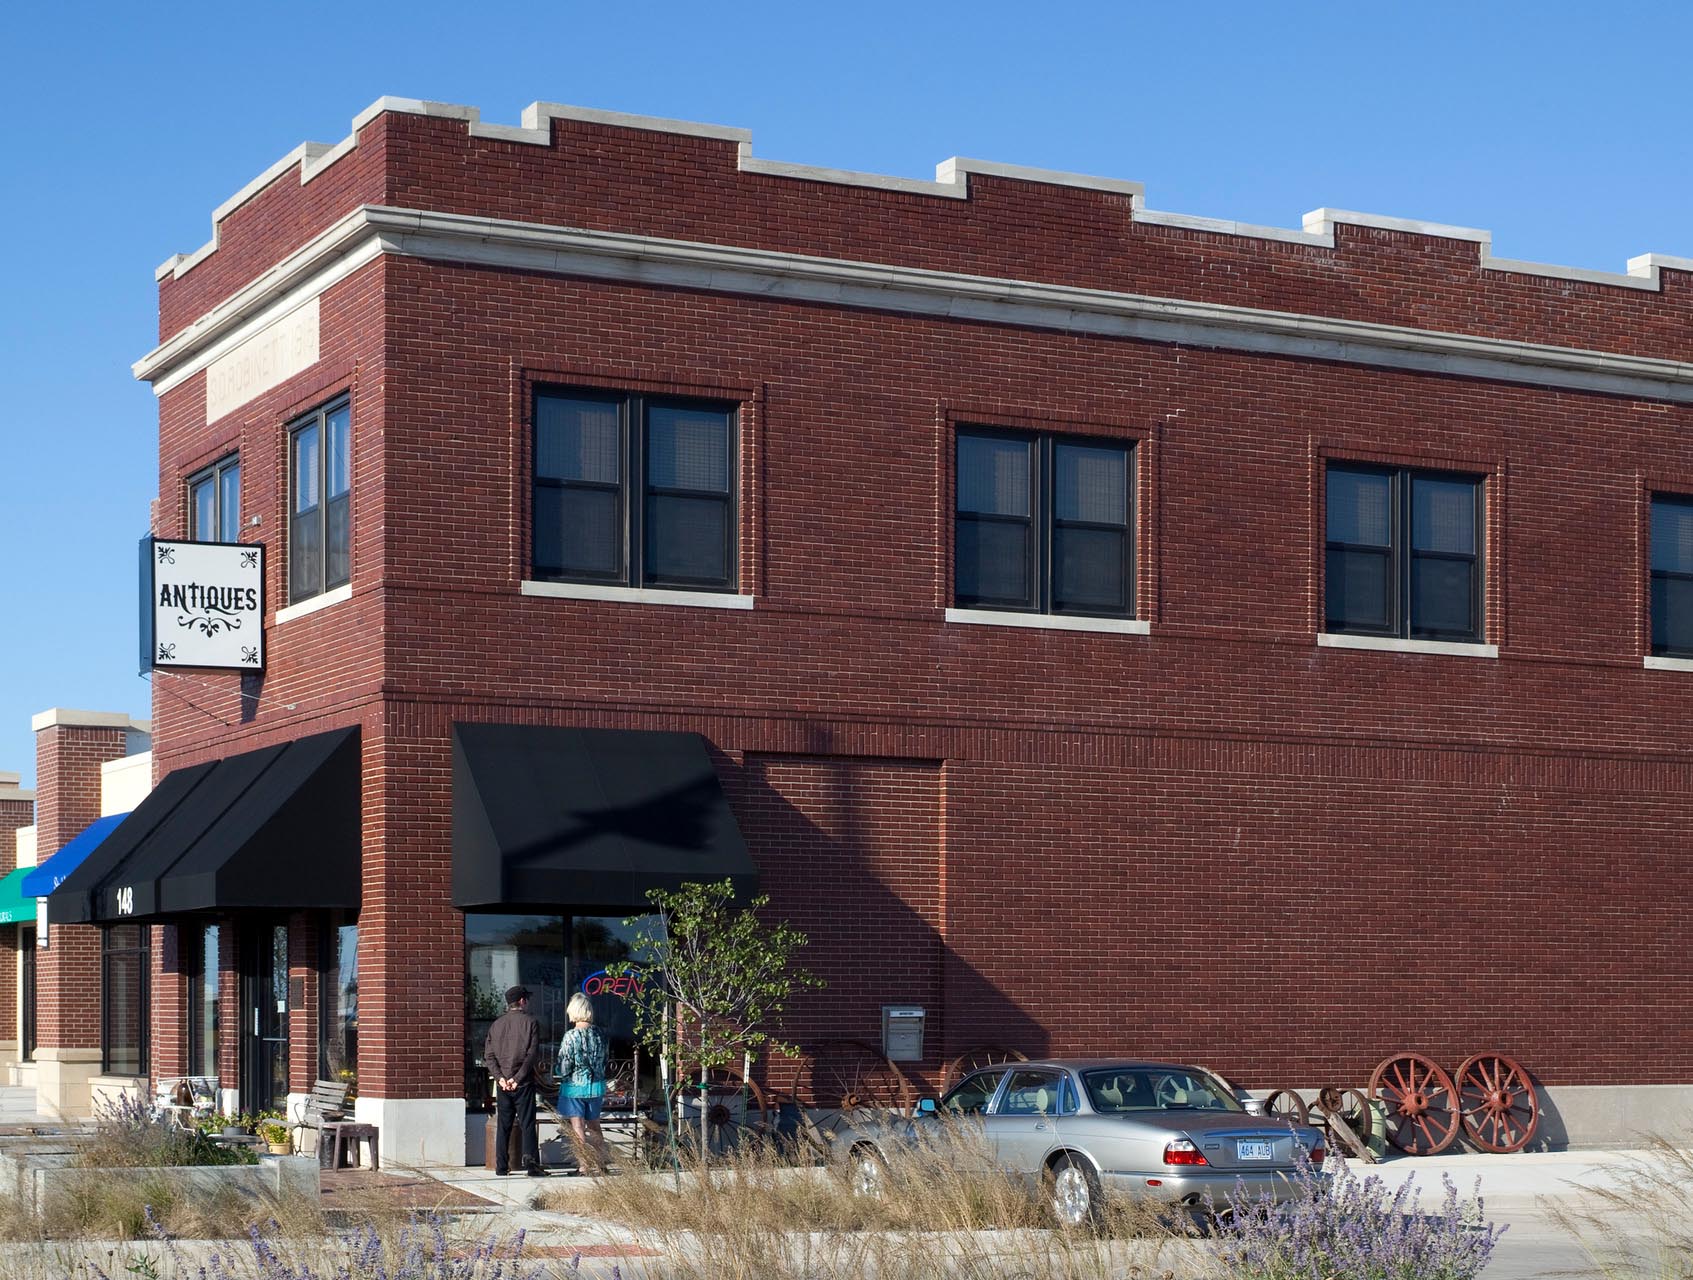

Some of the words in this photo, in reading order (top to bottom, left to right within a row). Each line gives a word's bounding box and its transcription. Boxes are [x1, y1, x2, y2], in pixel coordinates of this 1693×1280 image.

[160, 581, 257, 615] ANTIQUES
[116, 886, 133, 915] 148
[585, 977, 645, 996] OPEN
[1241, 1146, 1254, 1156] 464
